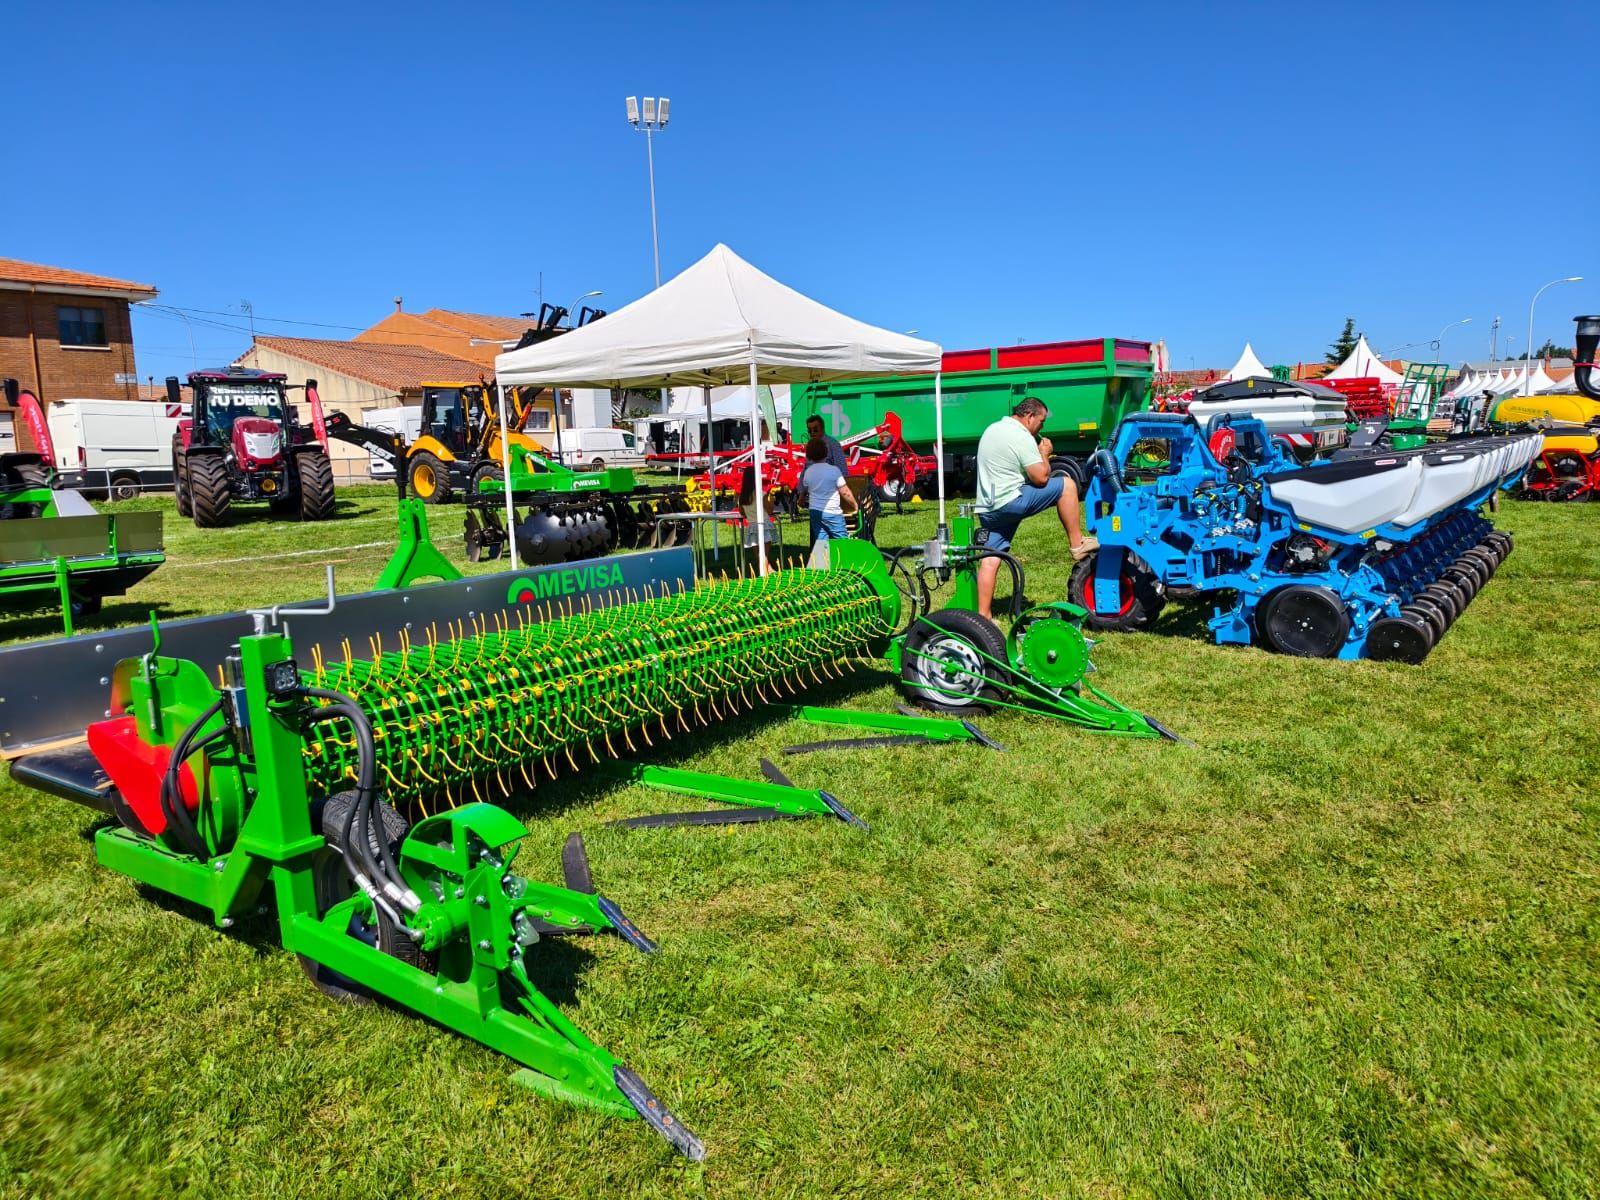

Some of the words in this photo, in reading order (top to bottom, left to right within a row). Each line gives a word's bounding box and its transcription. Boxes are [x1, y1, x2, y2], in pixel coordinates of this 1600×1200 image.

[210, 394, 230, 407] TU
[233, 394, 278, 406] DEMO
[362, 440, 396, 460] MST
[537, 562, 625, 599] MEVISA
